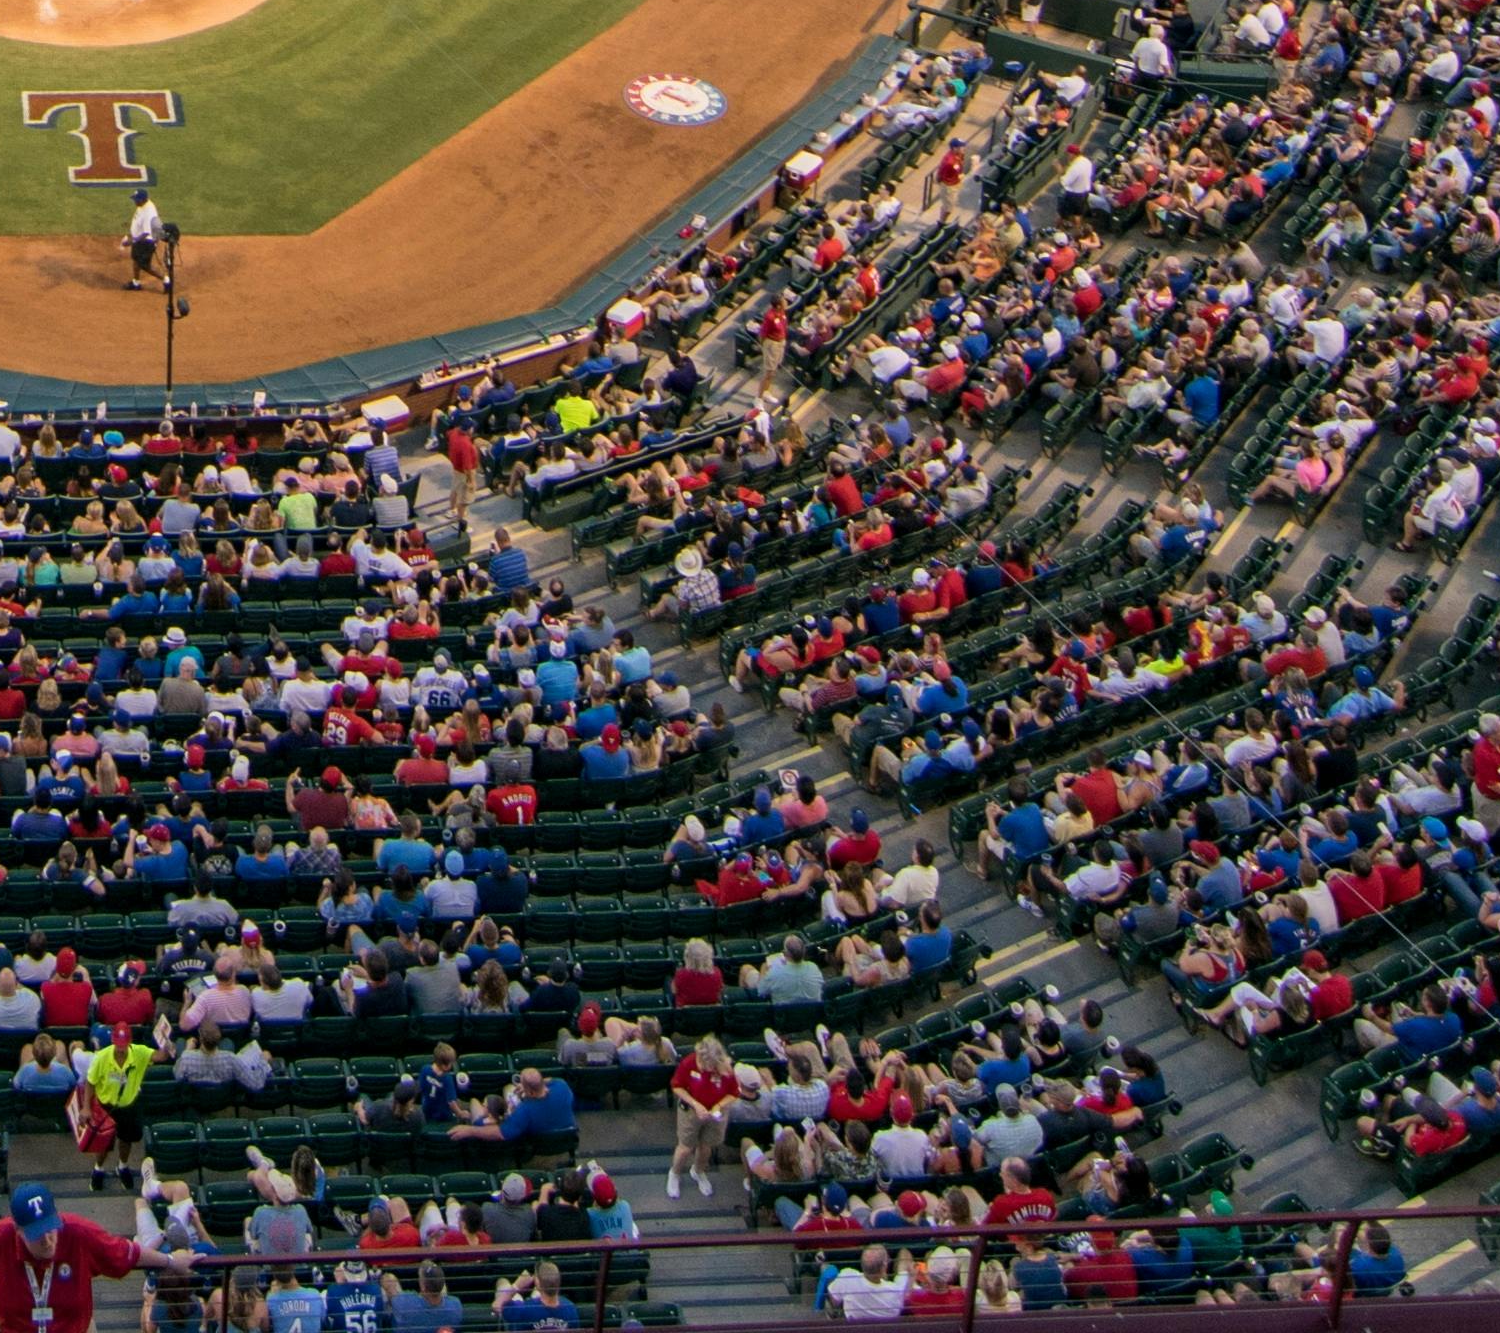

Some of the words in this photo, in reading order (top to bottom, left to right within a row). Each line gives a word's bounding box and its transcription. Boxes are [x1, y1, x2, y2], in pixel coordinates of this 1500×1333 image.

[650, 85, 699, 108] T
[21, 90, 178, 184] T
[428, 689, 451, 706] 66
[516, 806, 524, 824] 1
[27, 1195, 44, 1217] T
[340, 1293, 377, 1310] HOLLAND
